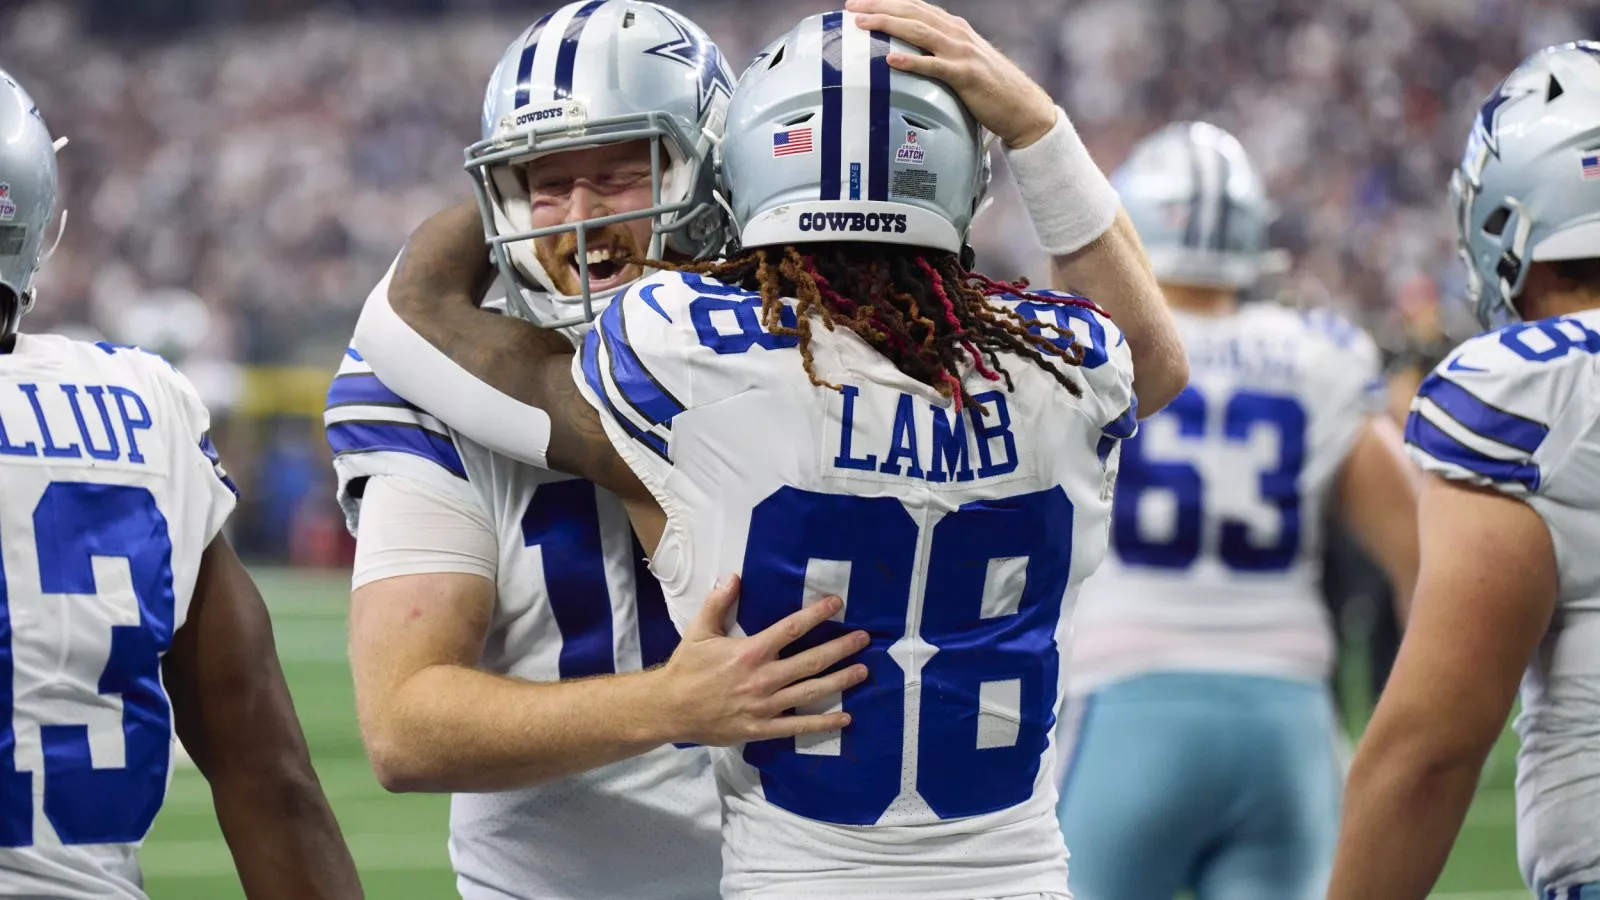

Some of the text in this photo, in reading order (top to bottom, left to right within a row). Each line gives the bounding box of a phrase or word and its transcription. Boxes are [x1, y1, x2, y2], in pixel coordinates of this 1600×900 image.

[516, 107, 563, 126] COWBOYS
[898, 149, 925, 160] CATCH
[851, 164, 859, 190] LAMB
[798, 212, 907, 233] COWBOYS
[834, 385, 1018, 482] LAMB
[1112, 386, 1307, 572] 63
[736, 484, 1074, 826] 88
